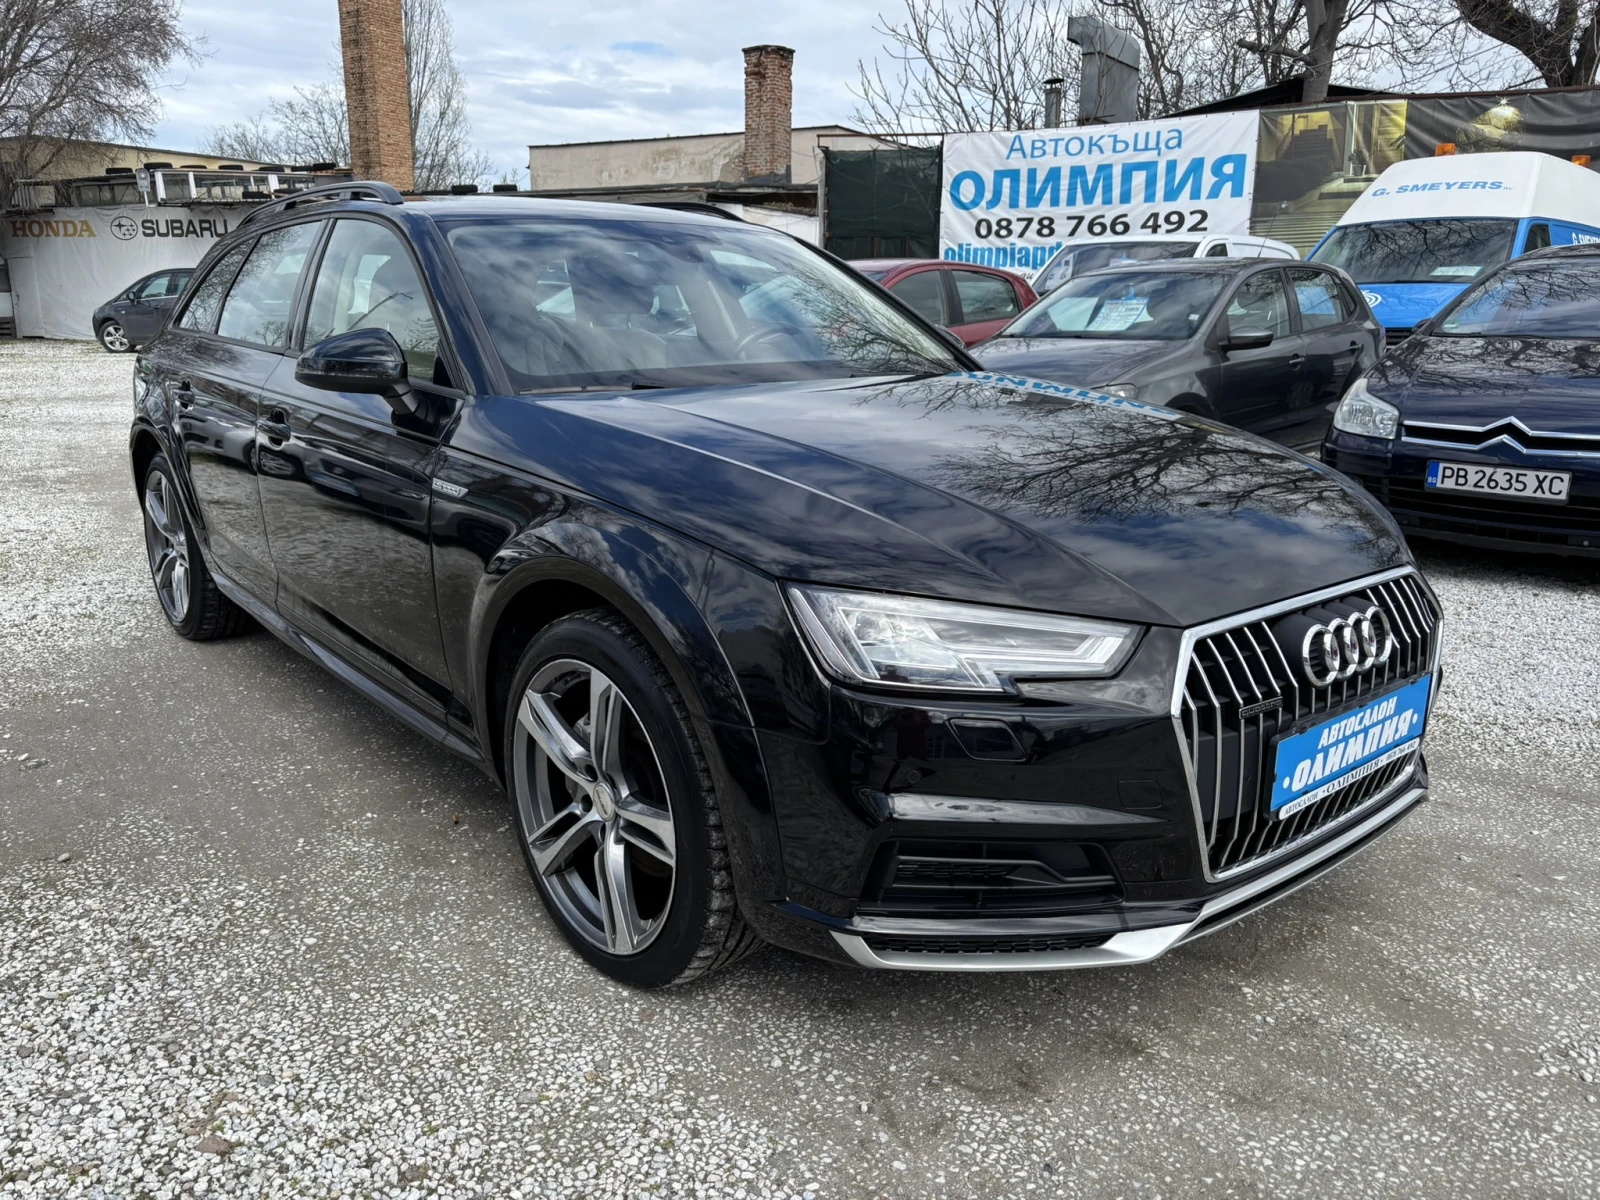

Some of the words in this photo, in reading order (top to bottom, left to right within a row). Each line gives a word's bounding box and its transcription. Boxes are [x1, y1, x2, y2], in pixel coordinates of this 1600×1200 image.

[1005, 128, 1183, 160] Автокъща
[949, 153, 1247, 211] ОЛИМПИЯ
[1396, 180, 1503, 194] SMEYERS
[10, 219, 97, 238] HONDA
[141, 218, 229, 238] SUBARU
[974, 216, 1056, 239] 0878
[1066, 213, 1131, 237] 766
[1140, 209, 1209, 235] 492
[1440, 466, 1469, 487] PB
[1472, 469, 1528, 492] 2635
[1532, 474, 1565, 496] XC
[1317, 696, 1398, 750] АВТОСАЛОН
[1291, 708, 1414, 793] ОЛИМПИЯ
[1326, 758, 1381, 794] ОЛИМПИЯ
